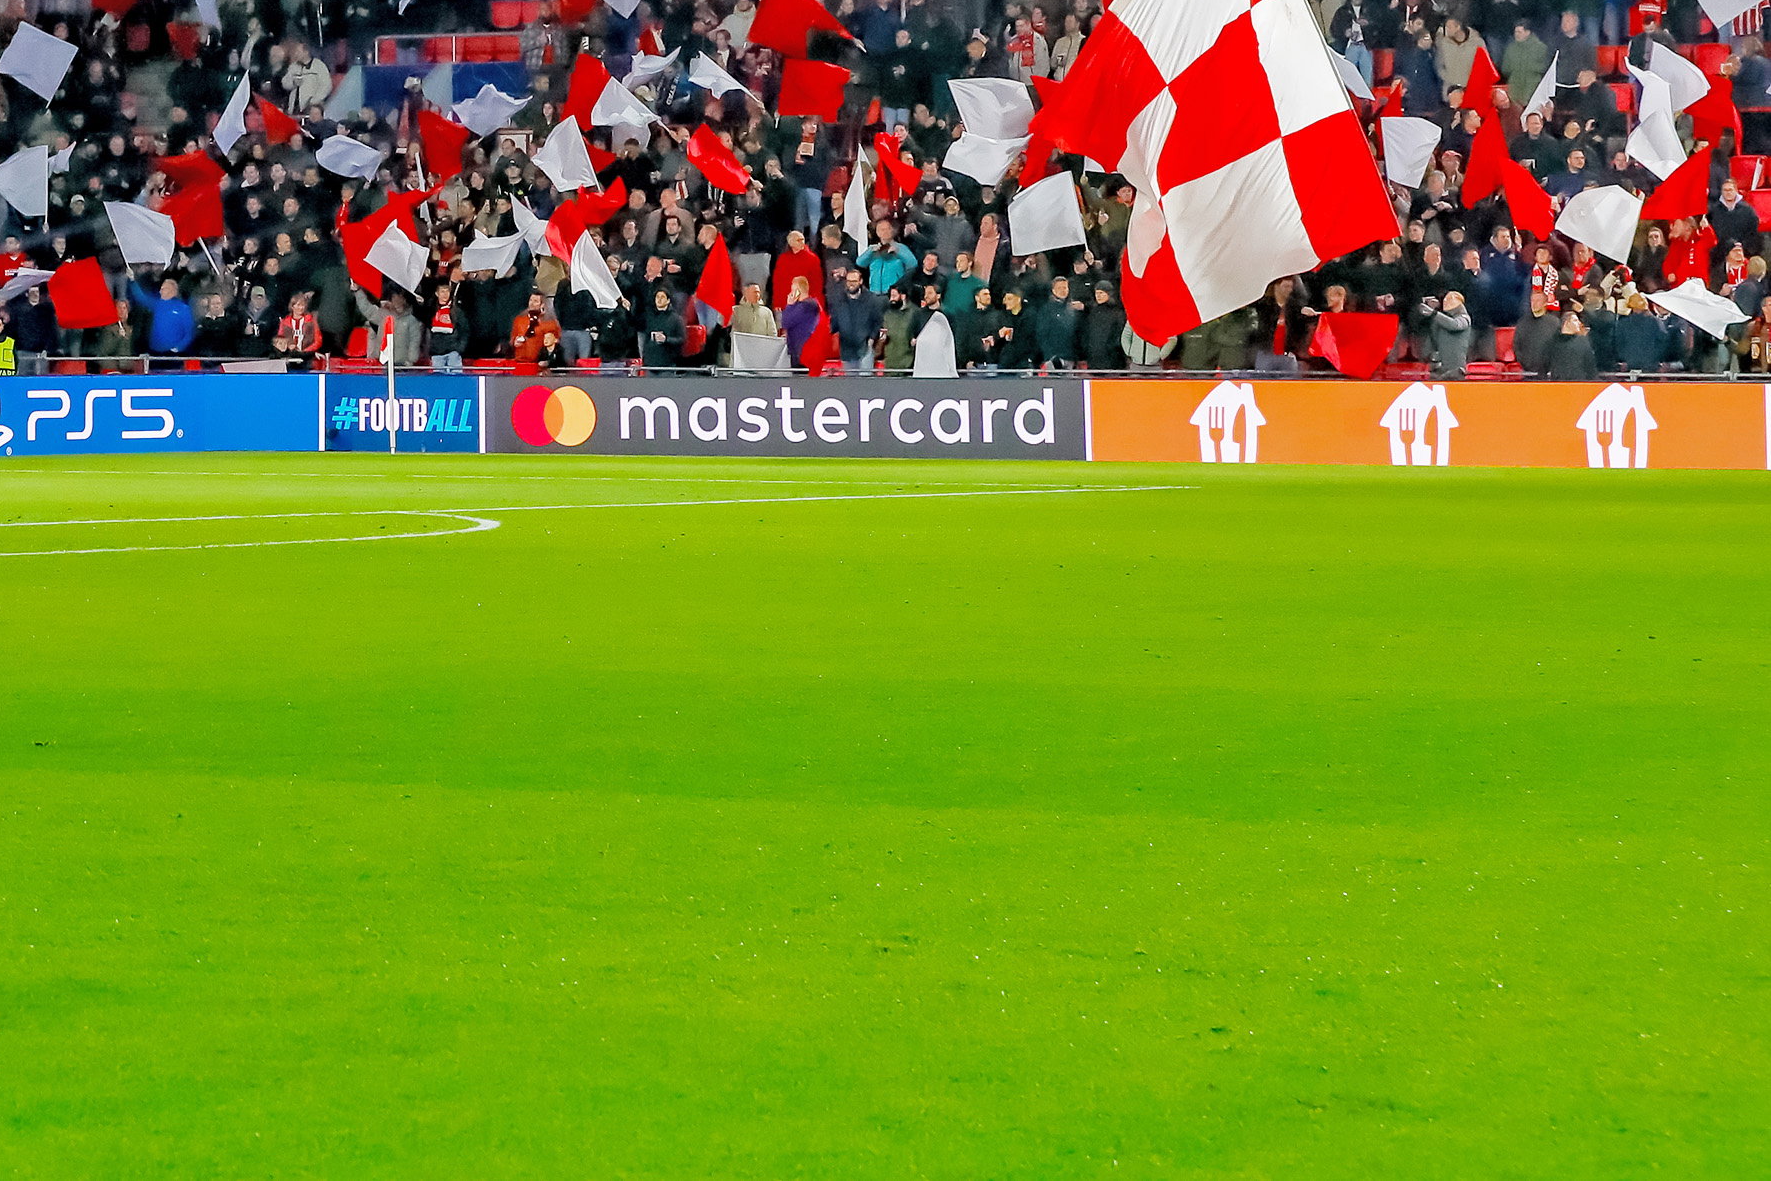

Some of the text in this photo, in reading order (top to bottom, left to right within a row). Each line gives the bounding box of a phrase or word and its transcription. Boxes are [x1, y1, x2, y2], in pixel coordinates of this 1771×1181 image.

[27, 388, 175, 441] PS5
[331, 397, 473, 432] #FOOTBALL
[618, 385, 1056, 445] mastercard
